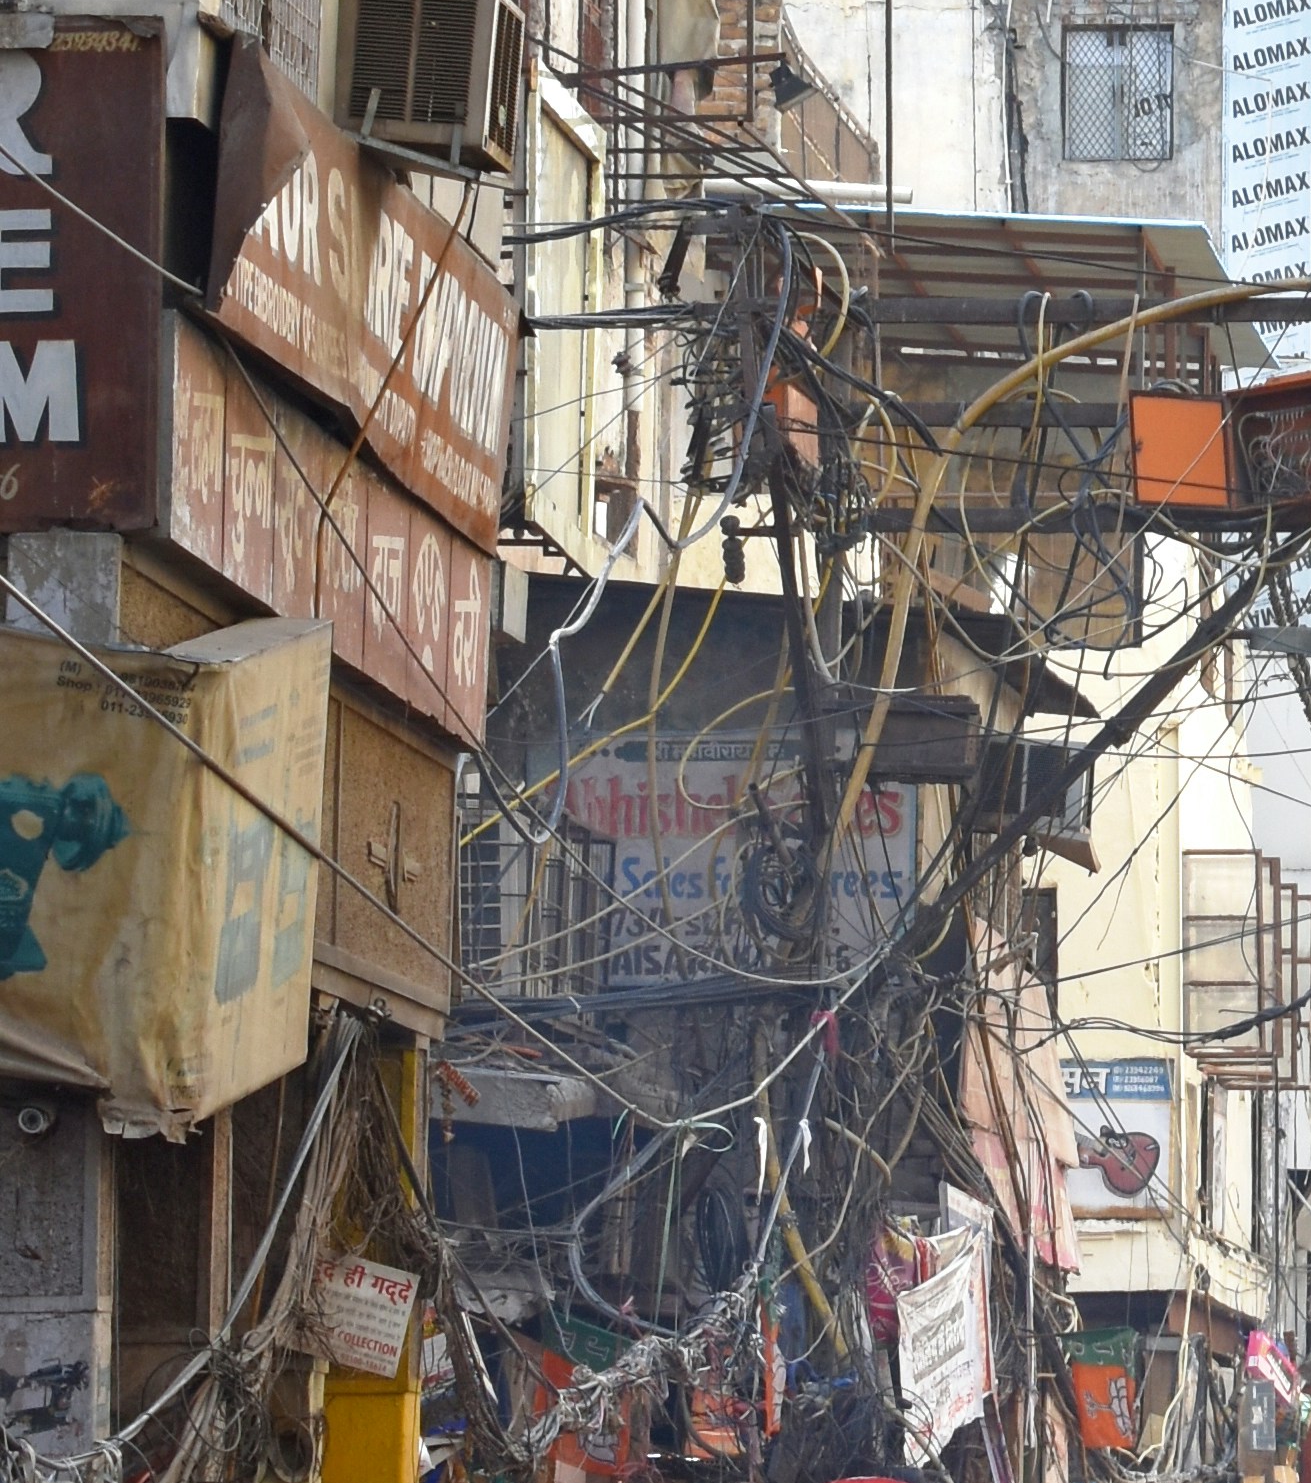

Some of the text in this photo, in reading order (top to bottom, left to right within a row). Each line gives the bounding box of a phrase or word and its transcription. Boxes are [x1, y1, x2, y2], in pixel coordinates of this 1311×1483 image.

[1232, 36, 1311, 72] ALOMAX
[1232, 81, 1311, 119] ALOMAX
[1232, 126, 1311, 163] ALOMAX
[1232, 171, 1311, 209] ALOMAX
